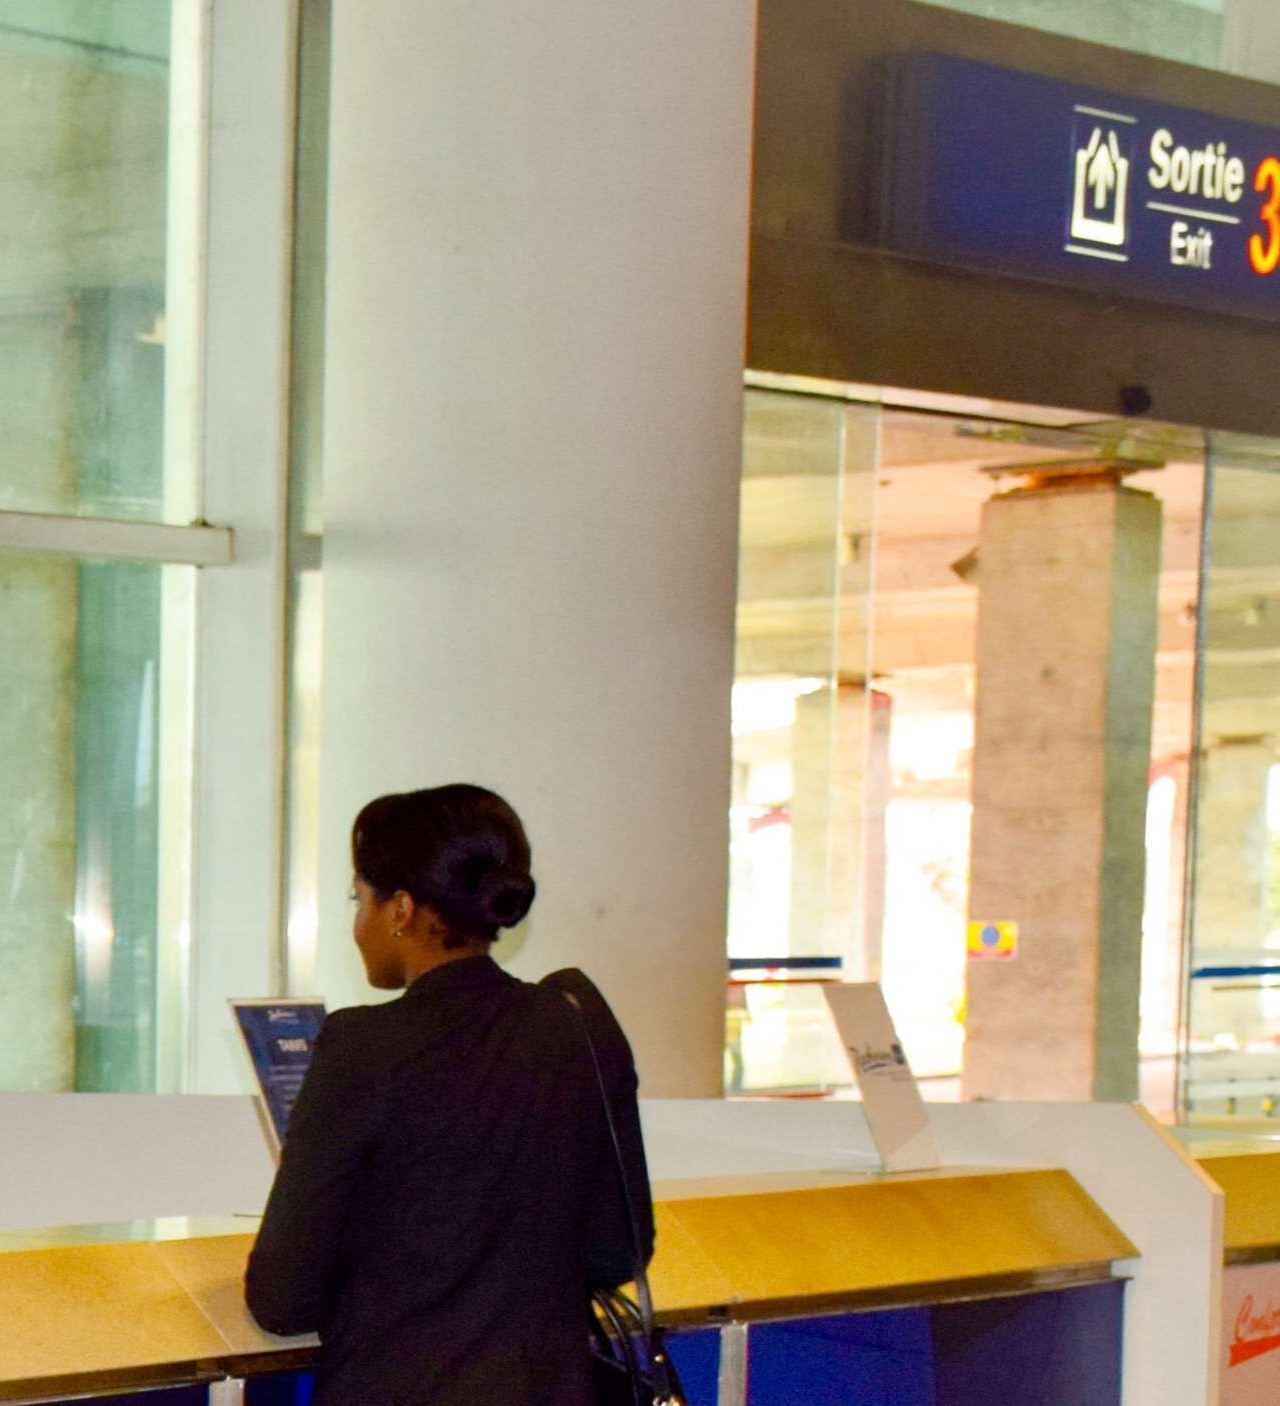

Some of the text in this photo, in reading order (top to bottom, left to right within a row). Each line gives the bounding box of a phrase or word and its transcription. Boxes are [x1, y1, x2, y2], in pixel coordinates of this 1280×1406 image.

[1147, 128, 1280, 275] Sortie 3
[1170, 221, 1213, 270] Exit
